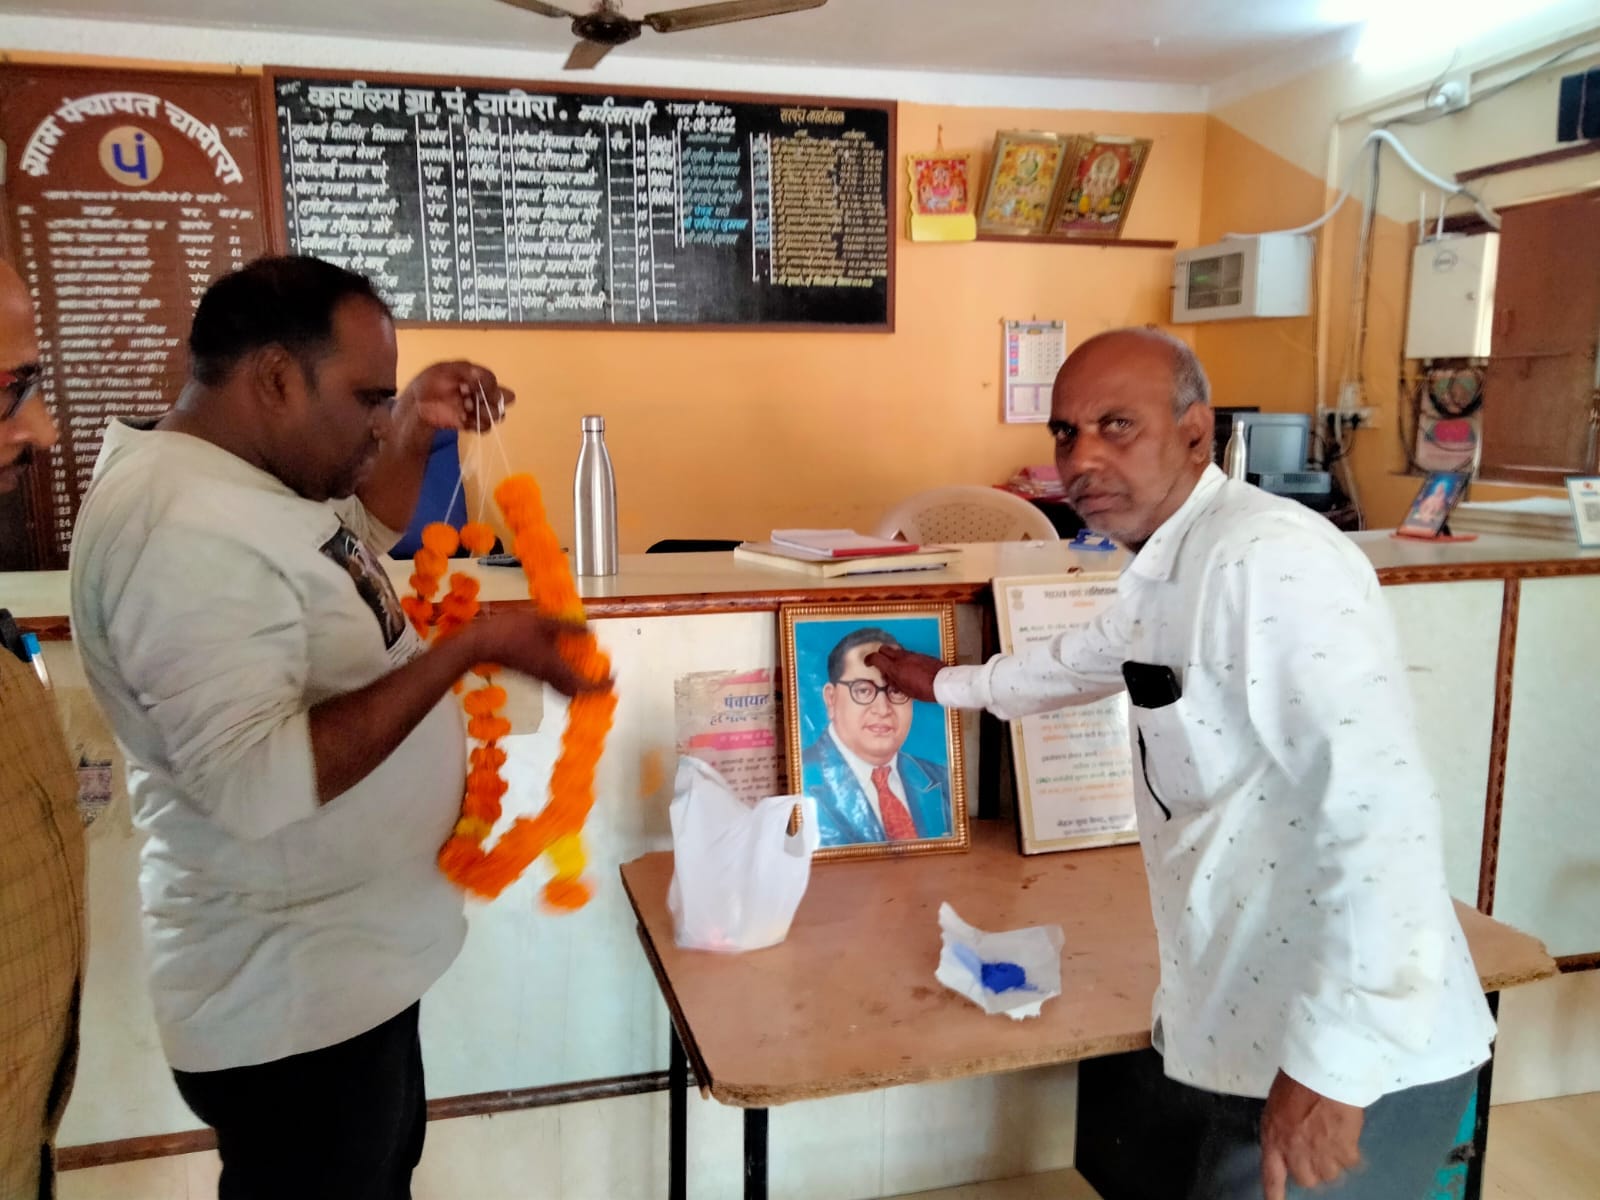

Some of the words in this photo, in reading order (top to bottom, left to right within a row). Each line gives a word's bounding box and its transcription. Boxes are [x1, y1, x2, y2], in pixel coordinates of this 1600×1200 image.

[308, 80, 401, 113] कार्यालय
[20, 115, 65, 177] ग्राम
[55, 91, 162, 123] पंचायत
